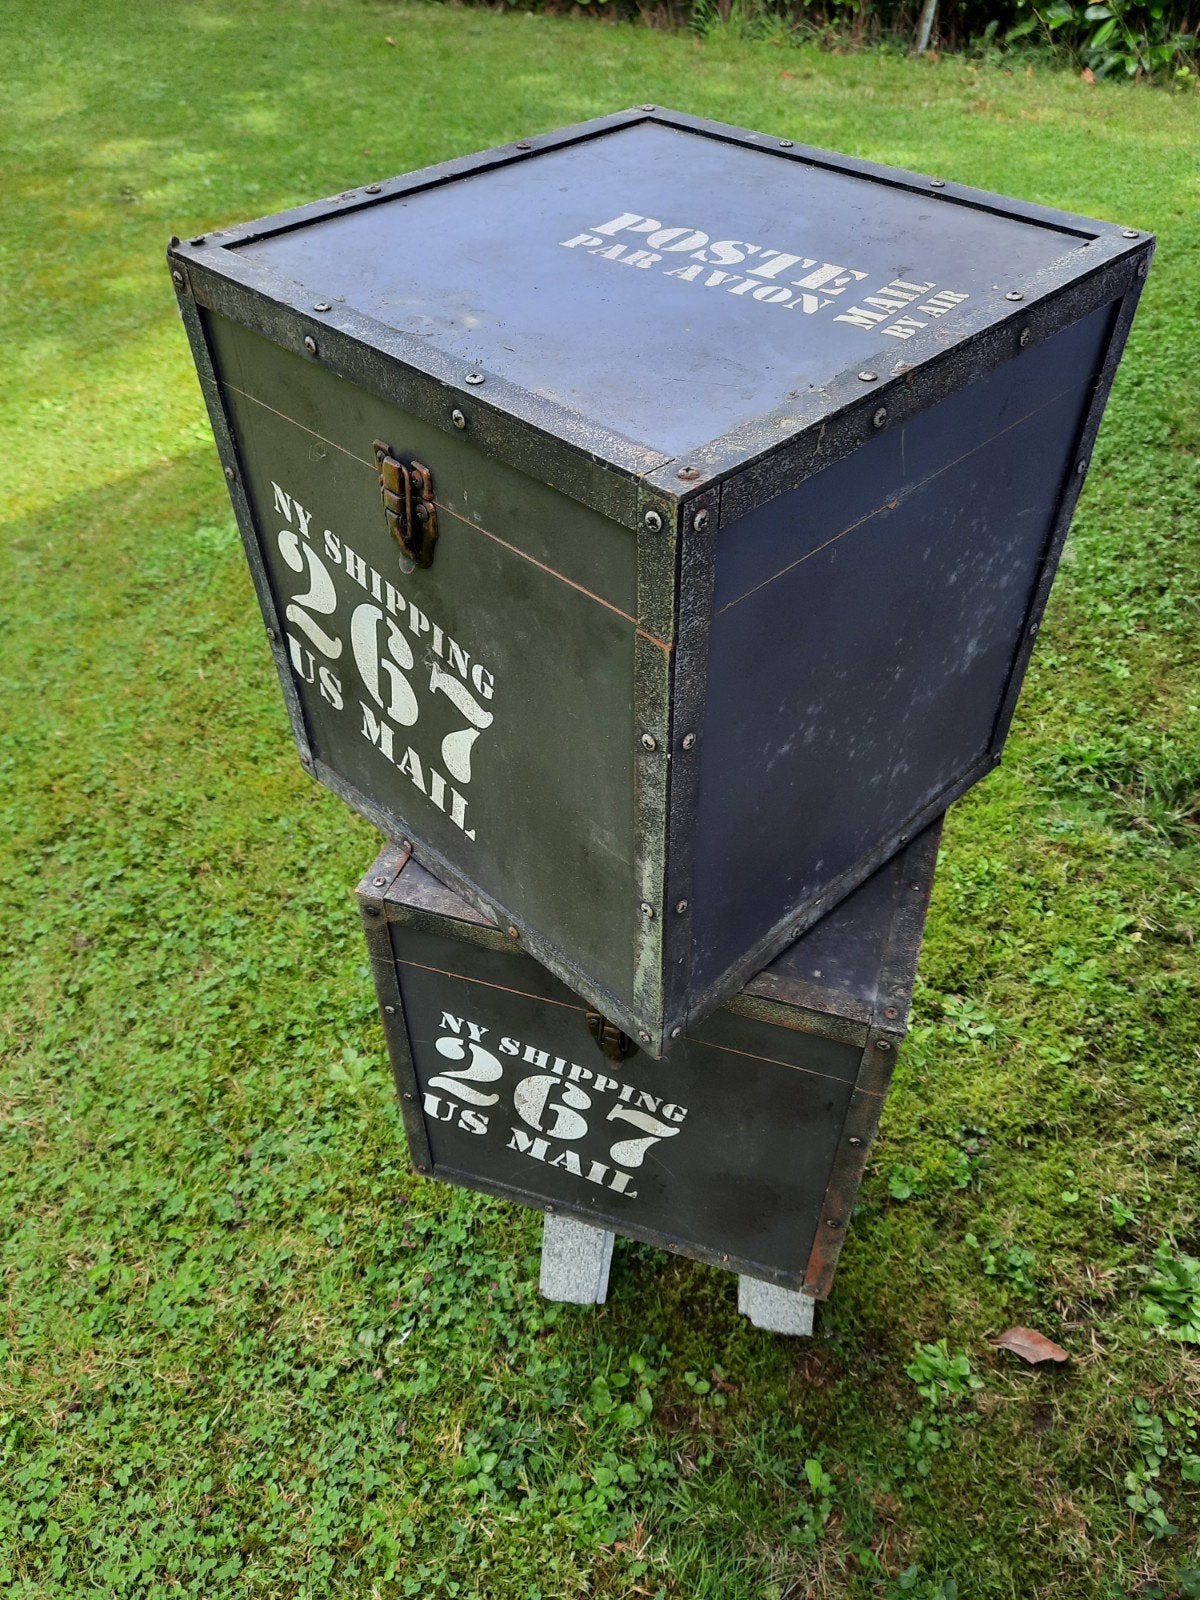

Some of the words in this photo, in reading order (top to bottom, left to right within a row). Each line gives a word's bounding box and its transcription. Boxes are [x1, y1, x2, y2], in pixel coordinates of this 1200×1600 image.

[558, 233, 663, 269] PAR
[663, 265, 836, 315] AVION
[590, 212, 869, 296] POSTE
[832, 278, 937, 330] MAIL
[880, 315, 928, 340] BY
[917, 289, 970, 319] AIR
[271, 480, 313, 539] NY
[323, 529, 495, 700] SHIPPING
[278, 530, 494, 784] 267
[286, 632, 344, 711] US
[359, 700, 476, 842] MAIL
[428, 1036, 681, 1168] 267
[438, 1011, 489, 1042] NY
[498, 1036, 688, 1123] SHIPPING
[423, 1092, 490, 1135] US
[506, 1127, 638, 1199] MAIL
